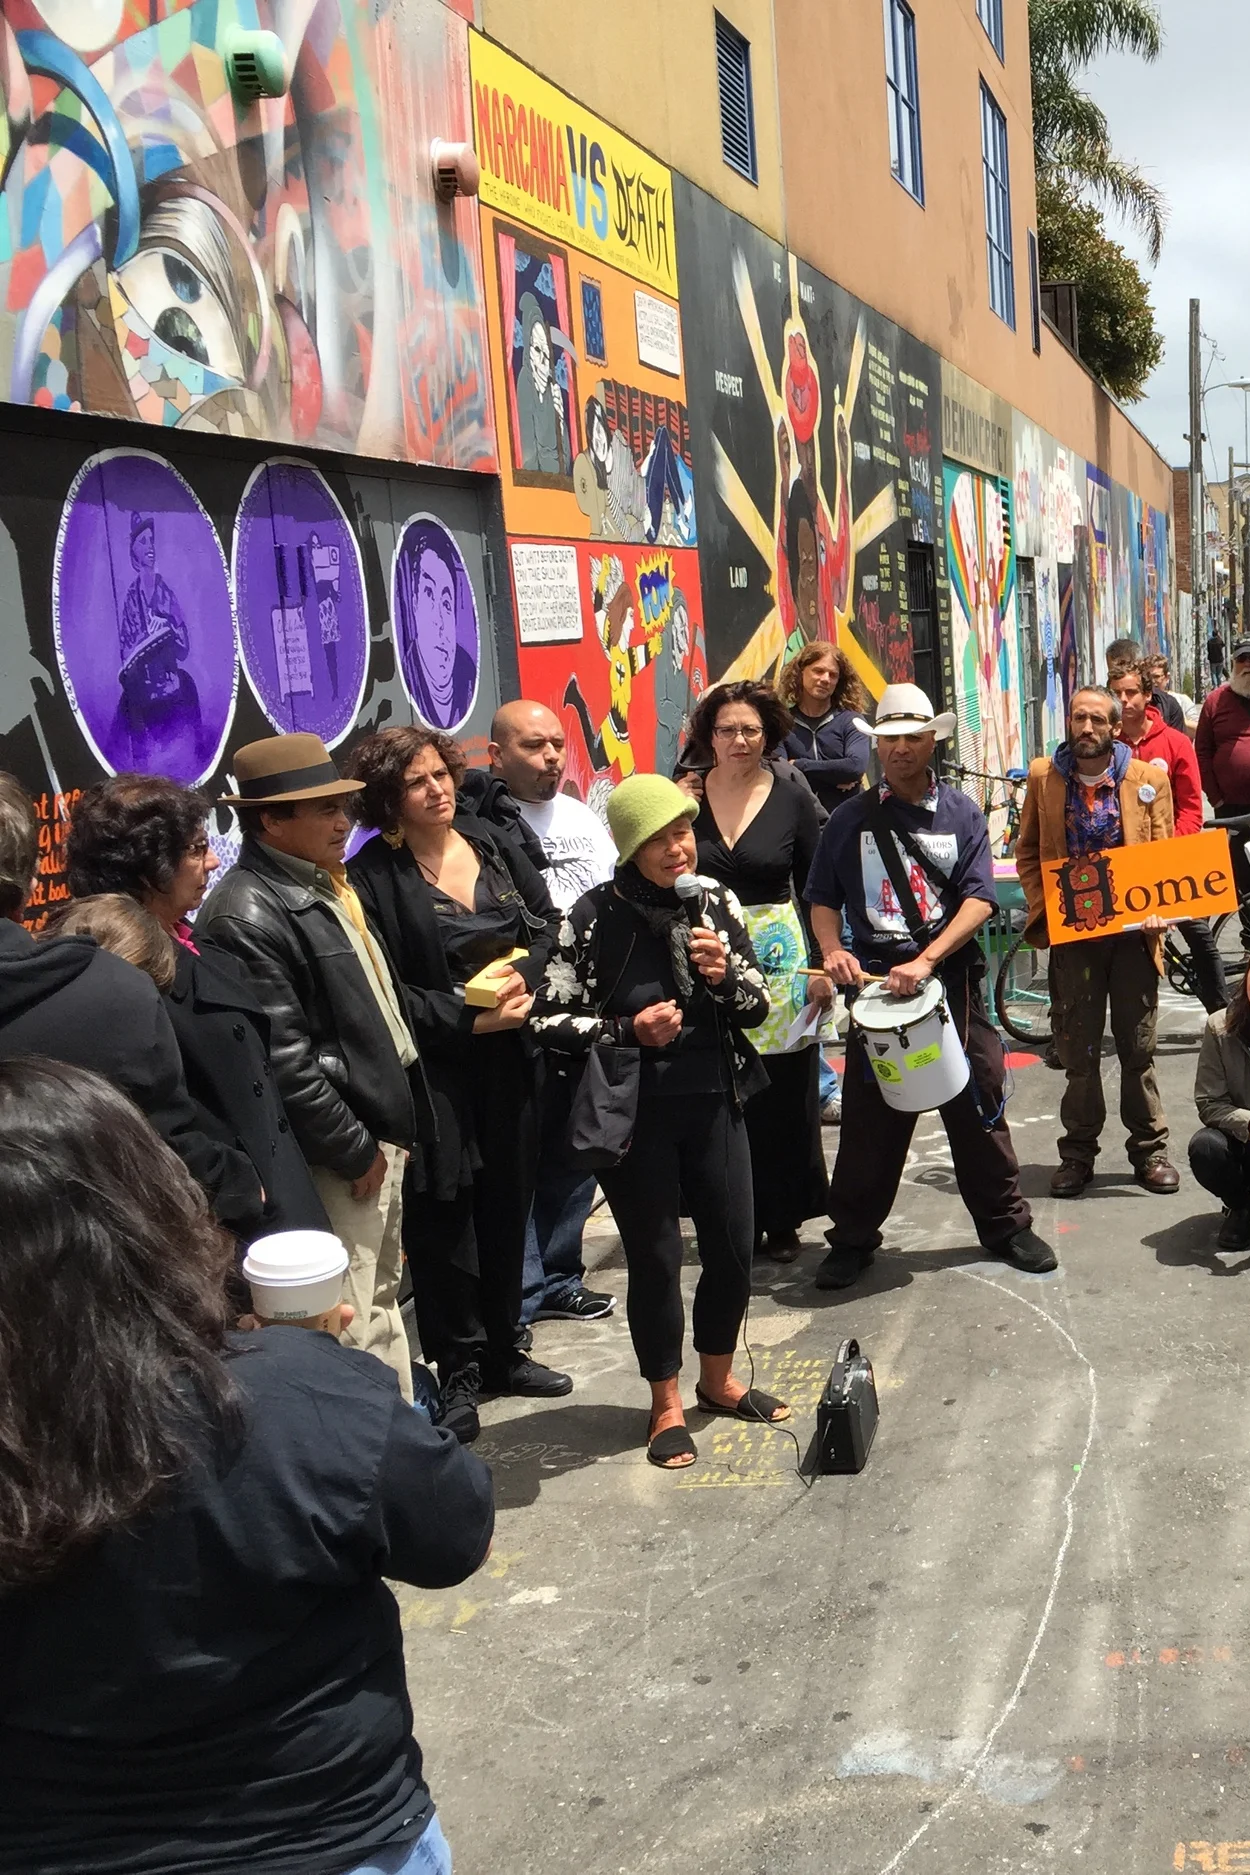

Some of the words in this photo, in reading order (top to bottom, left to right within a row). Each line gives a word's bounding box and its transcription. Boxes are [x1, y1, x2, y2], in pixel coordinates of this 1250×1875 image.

[475, 79, 570, 216] NARCANIA
[566, 124, 608, 241] VS
[611, 156, 672, 280] DEATH
[715, 370, 743, 398] RESPECT
[729, 566, 748, 588] LAND
[1049, 855, 1229, 927] Home
